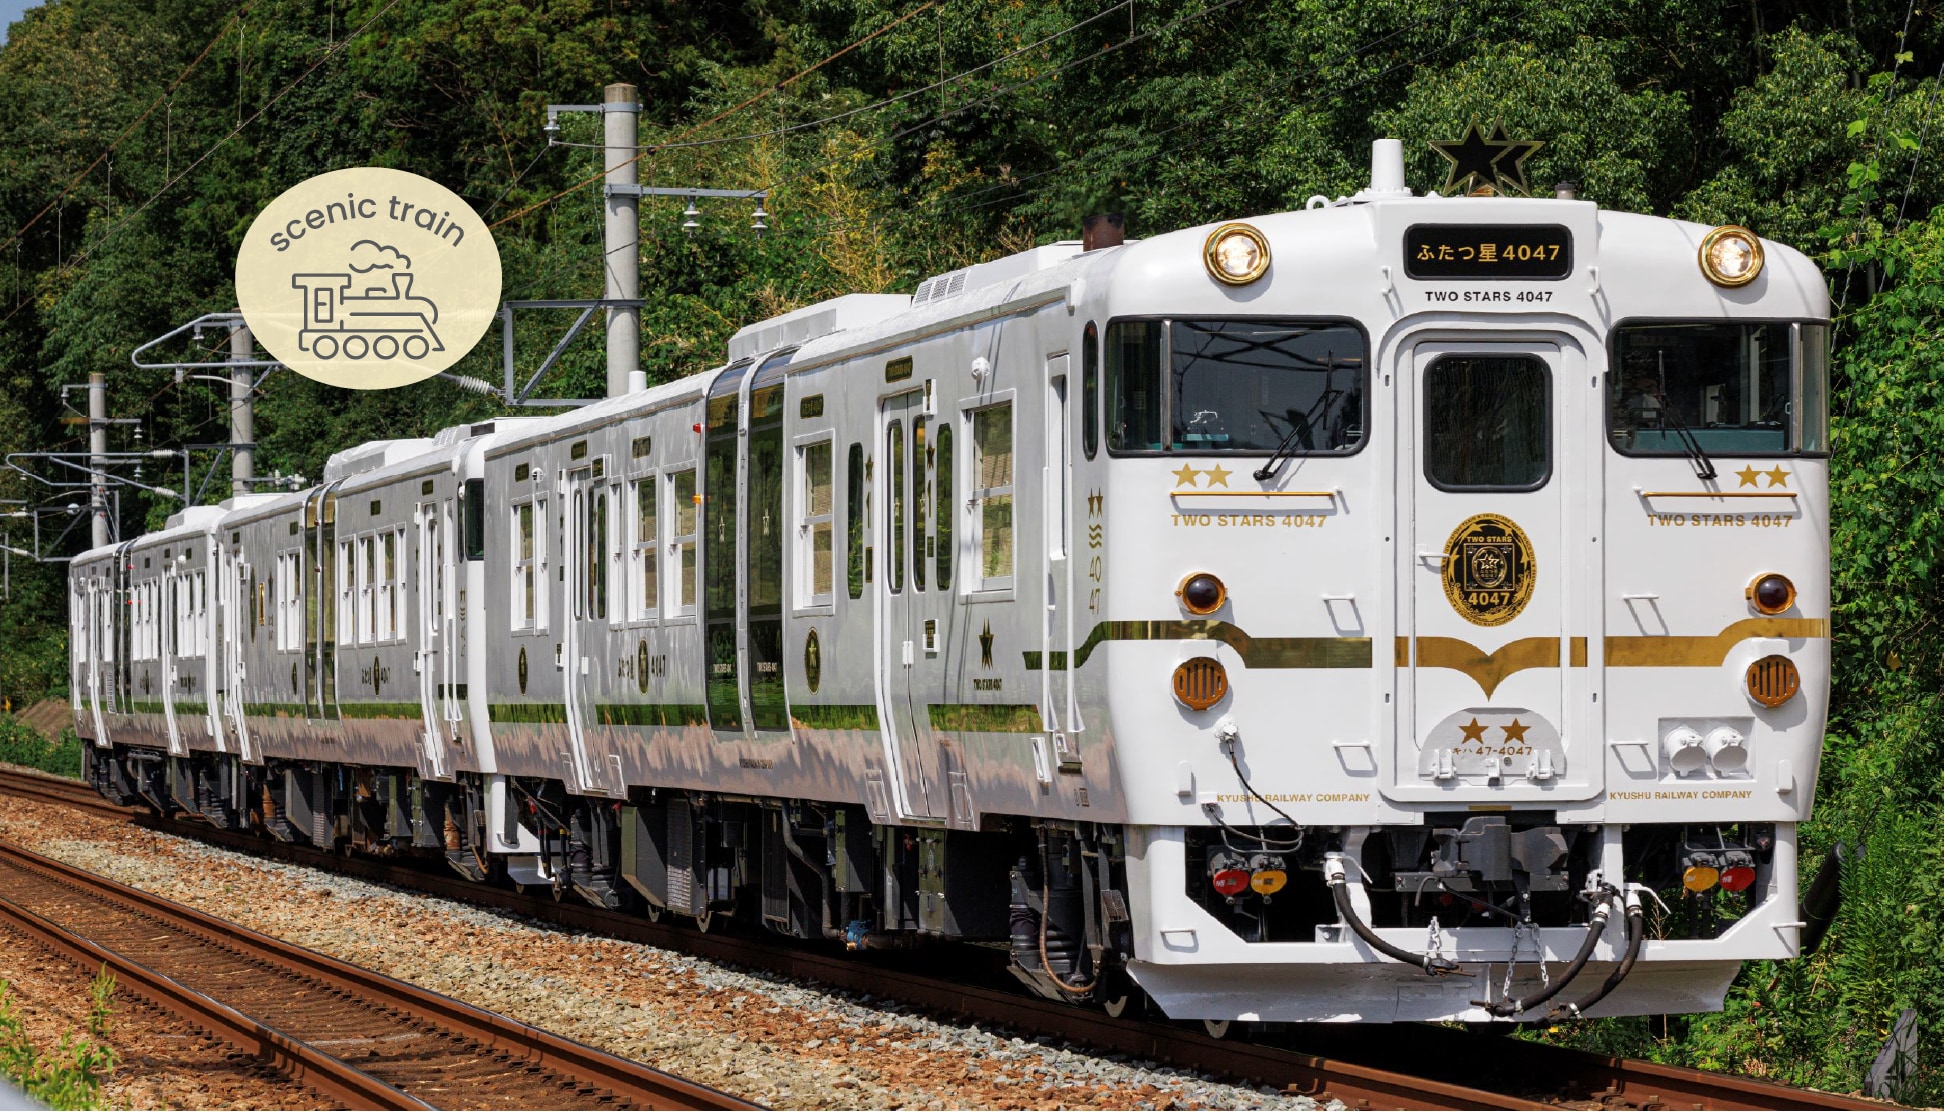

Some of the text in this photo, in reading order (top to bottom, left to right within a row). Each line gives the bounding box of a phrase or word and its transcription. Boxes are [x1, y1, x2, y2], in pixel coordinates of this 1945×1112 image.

[1417, 244, 1560, 262] ふたつ星 4047
[1425, 291, 1553, 302] TWO STARS 4047
[1171, 514, 1327, 528] TWO STARS 4047
[1647, 514, 1793, 528] TWO STARS 4047
[1089, 555, 1102, 583] 40
[1468, 592, 1511, 606] 4047
[1475, 746, 1533, 756] 47-4047
[1264, 793, 1312, 802] RAILWAY
[1316, 793, 1370, 802] COMPANY
[1610, 790, 1752, 800] KYUSHU RAILWAY COMPANY
